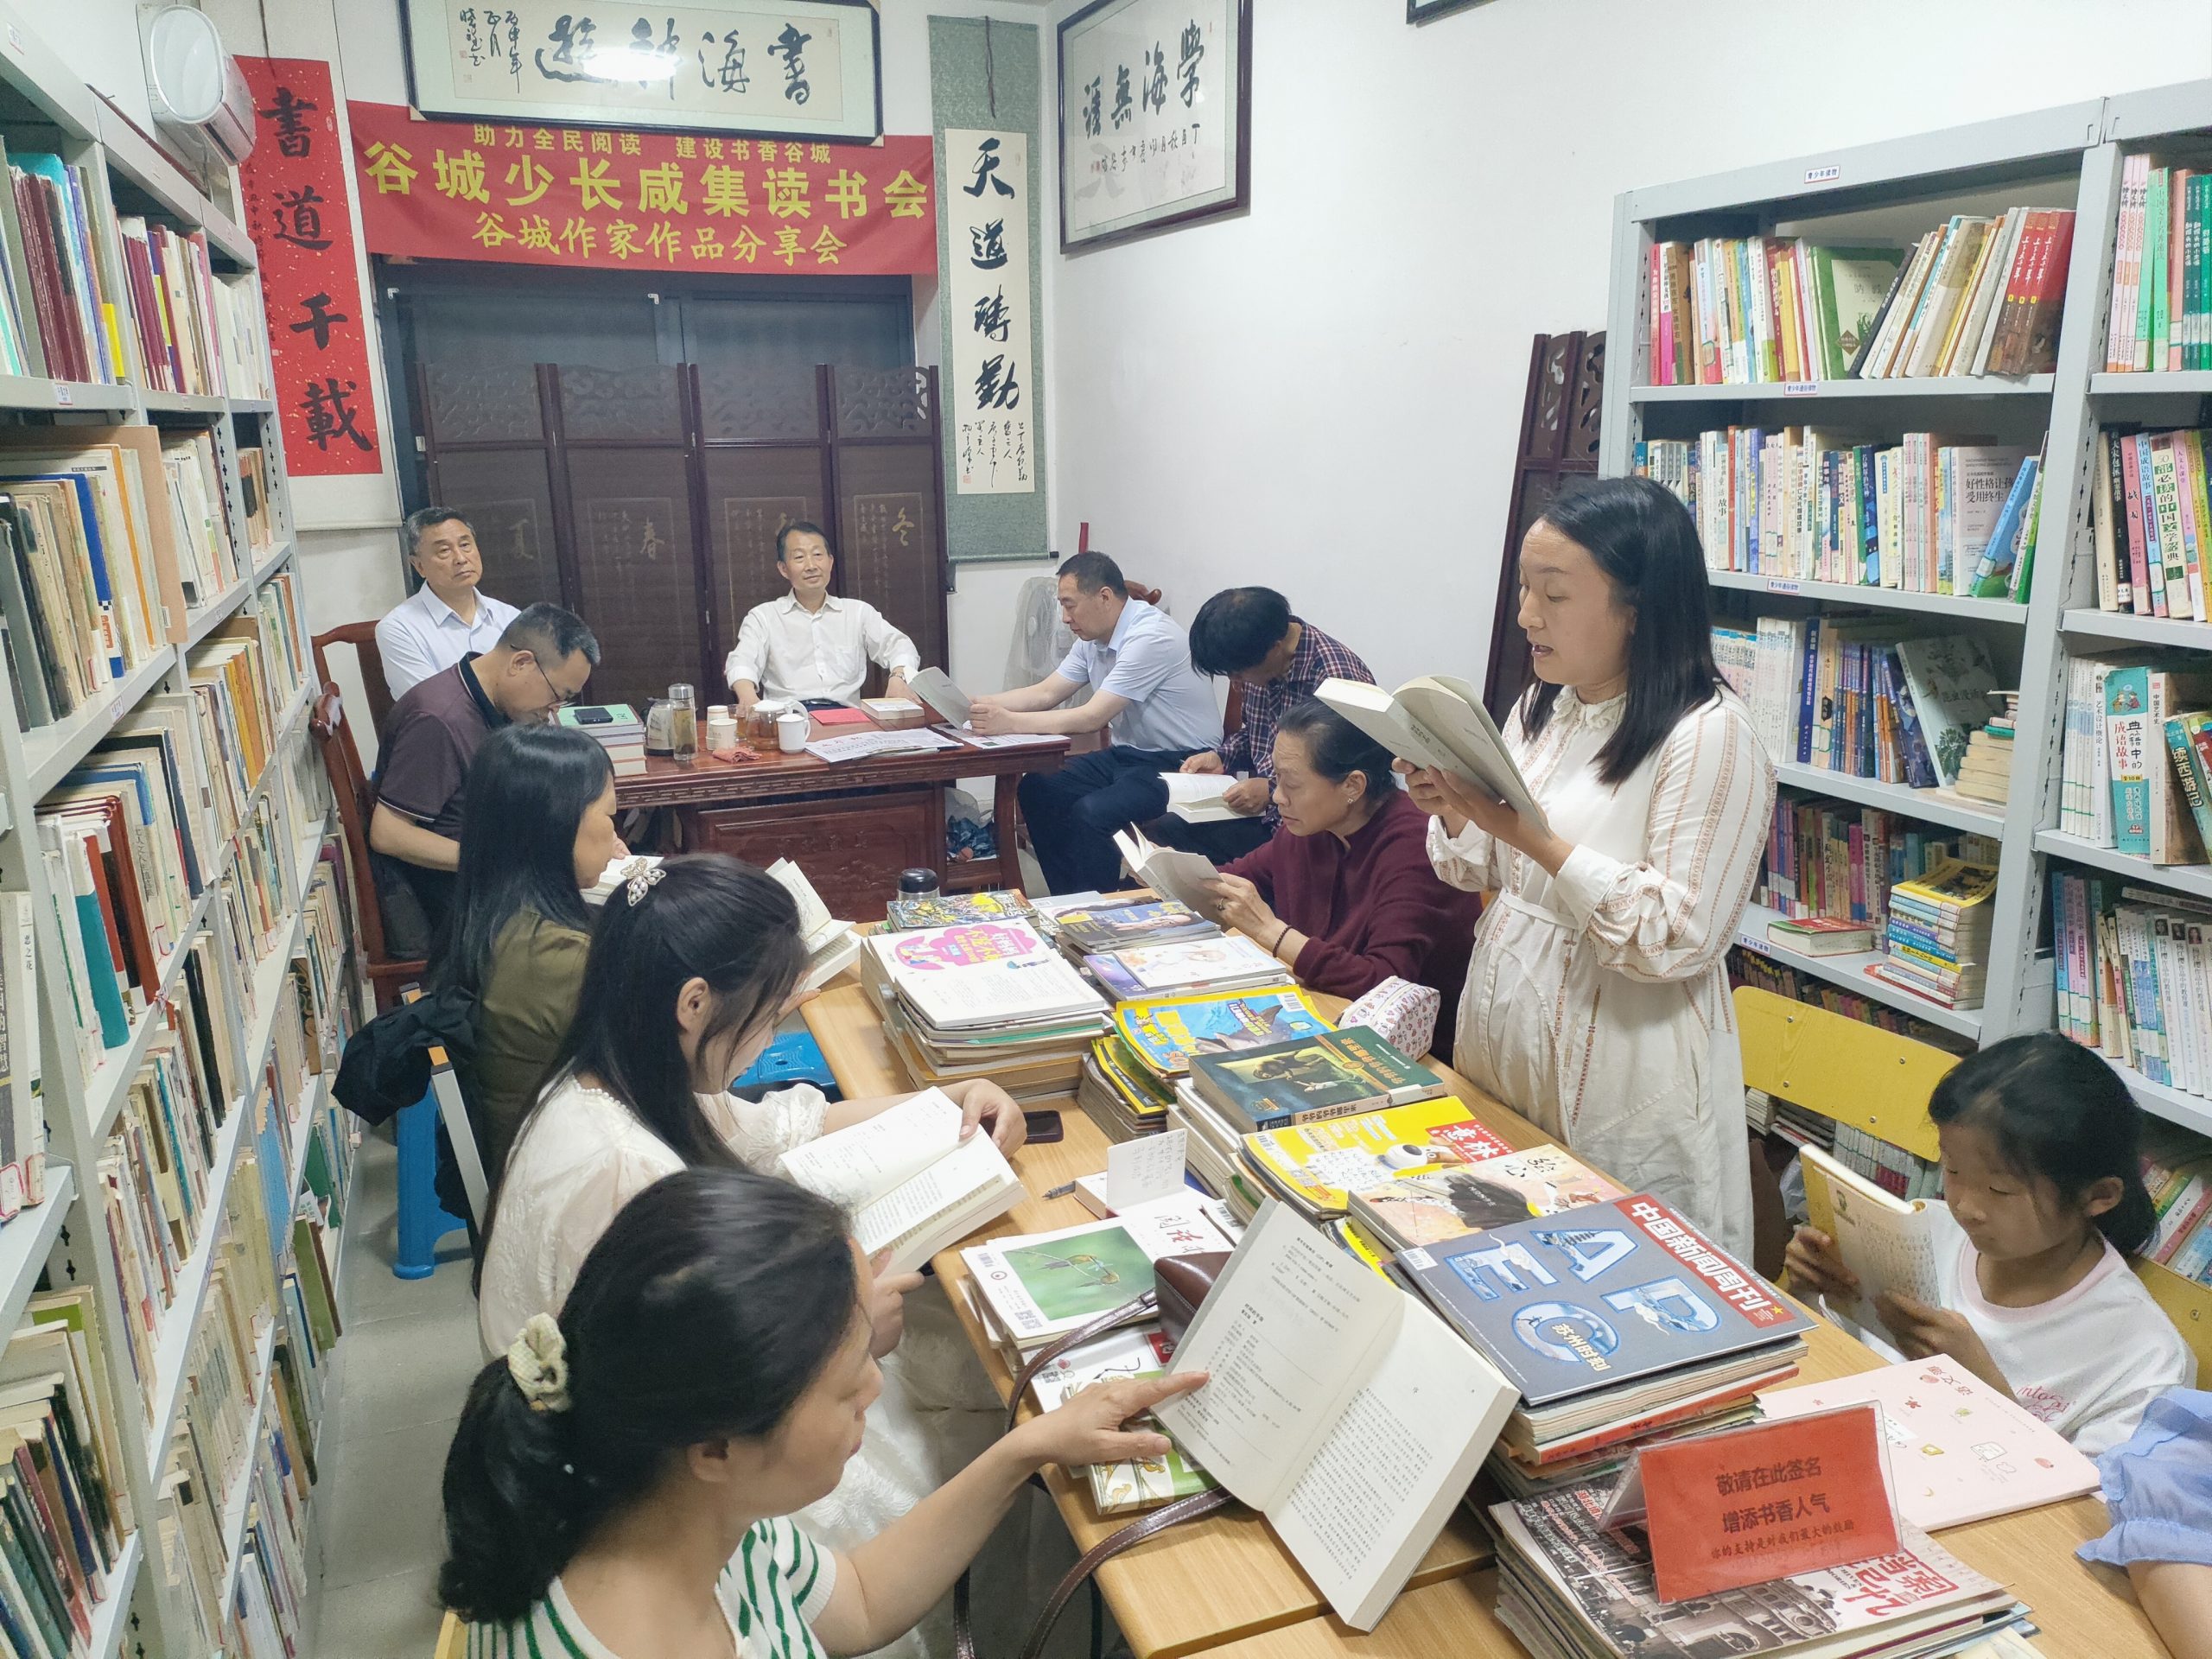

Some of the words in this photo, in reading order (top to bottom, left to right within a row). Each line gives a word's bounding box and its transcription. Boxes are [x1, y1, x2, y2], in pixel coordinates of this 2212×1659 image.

[473, 123, 642, 158] 助力全民阅读
[675, 136, 832, 166] 建设书香谷城
[365, 140, 929, 220] 谷城少长咸集读书会
[473, 212, 849, 267] 谷城作家作品分享会
[2137, 440, 2154, 489] 中国成语故事
[1965, 490, 2005, 503] 受用终生
[1445, 1123, 1500, 1160] 意林
[1630, 1200, 1775, 1313] 中国新闻周刊
[1551, 1321, 1612, 1373] 苏州时刻
[1713, 1454, 1823, 1498] 敬请在此签名
[1720, 1491, 1831, 1535] 增添书香人气
[1709, 1518, 1856, 1560] 你的支持是对我们最大的鼓励
